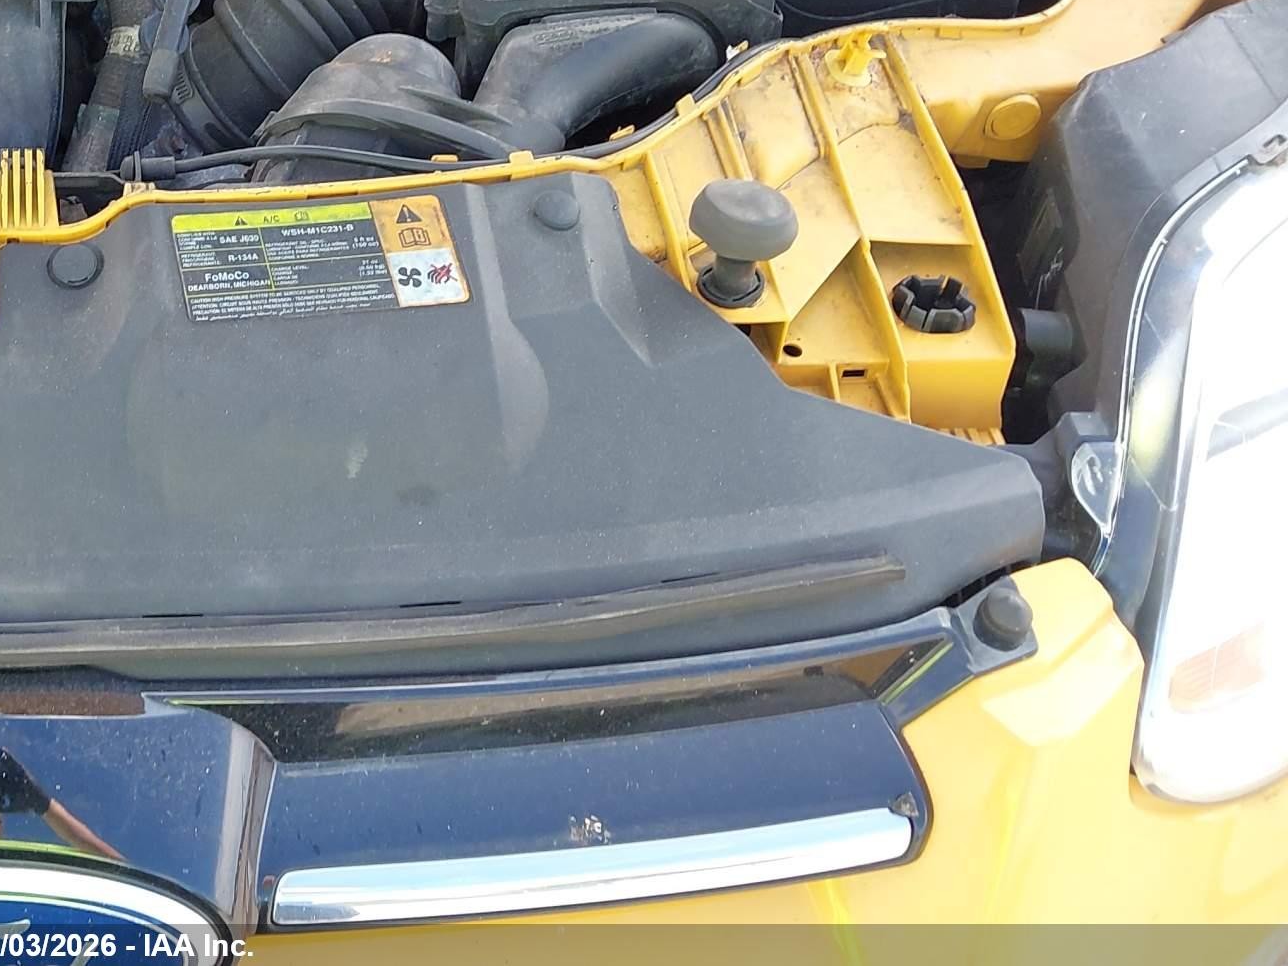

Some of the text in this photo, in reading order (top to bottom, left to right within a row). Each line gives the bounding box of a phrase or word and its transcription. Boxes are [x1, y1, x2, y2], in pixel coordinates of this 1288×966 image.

[263, 215, 280, 223] A/C
[280, 224, 355, 236] WSH-M1C231-B
[219, 235, 238, 244] SAE
[228, 253, 259, 262] R-134A
[204, 270, 250, 283] FoMoCo
[188, 282, 233, 292] DEARBORN,
[233, 279, 271, 288] MICHIGAN
